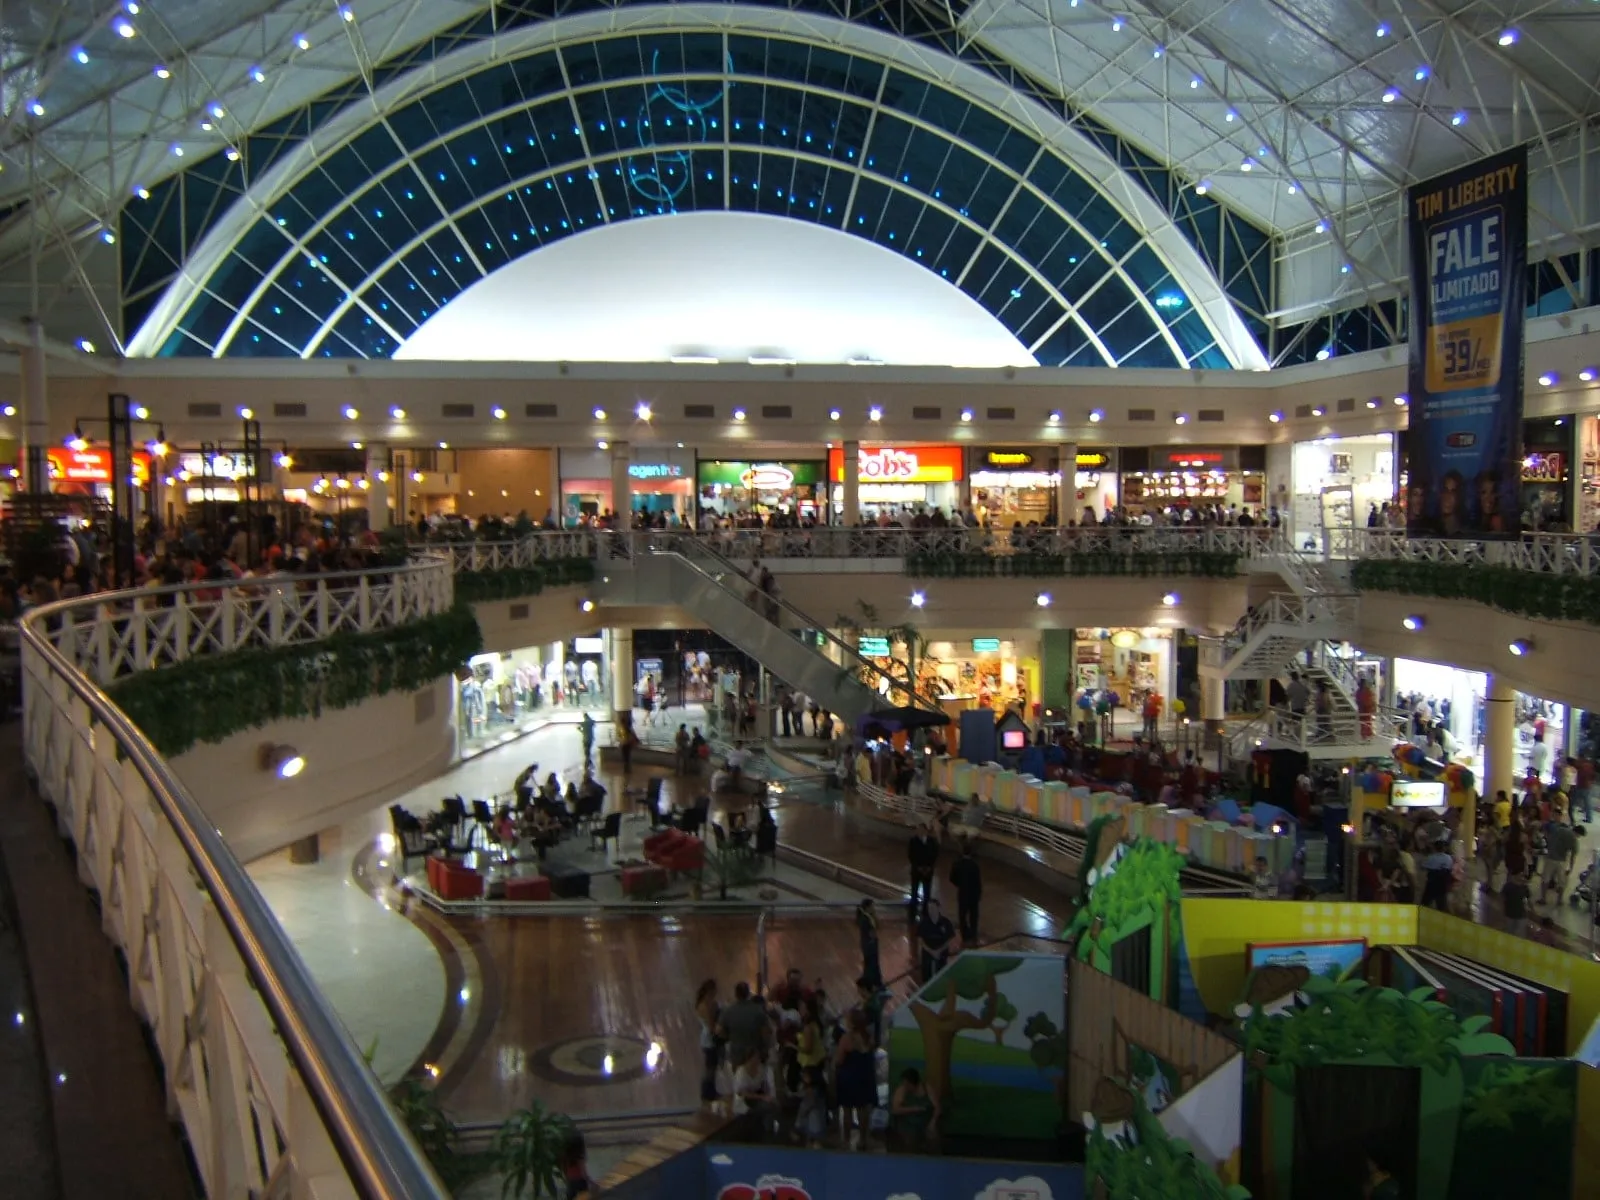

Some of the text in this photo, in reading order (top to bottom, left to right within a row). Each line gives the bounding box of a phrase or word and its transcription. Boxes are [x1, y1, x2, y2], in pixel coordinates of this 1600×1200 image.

[1416, 164, 1518, 221] TIM LIBERTY
[1430, 215, 1499, 277] FALE
